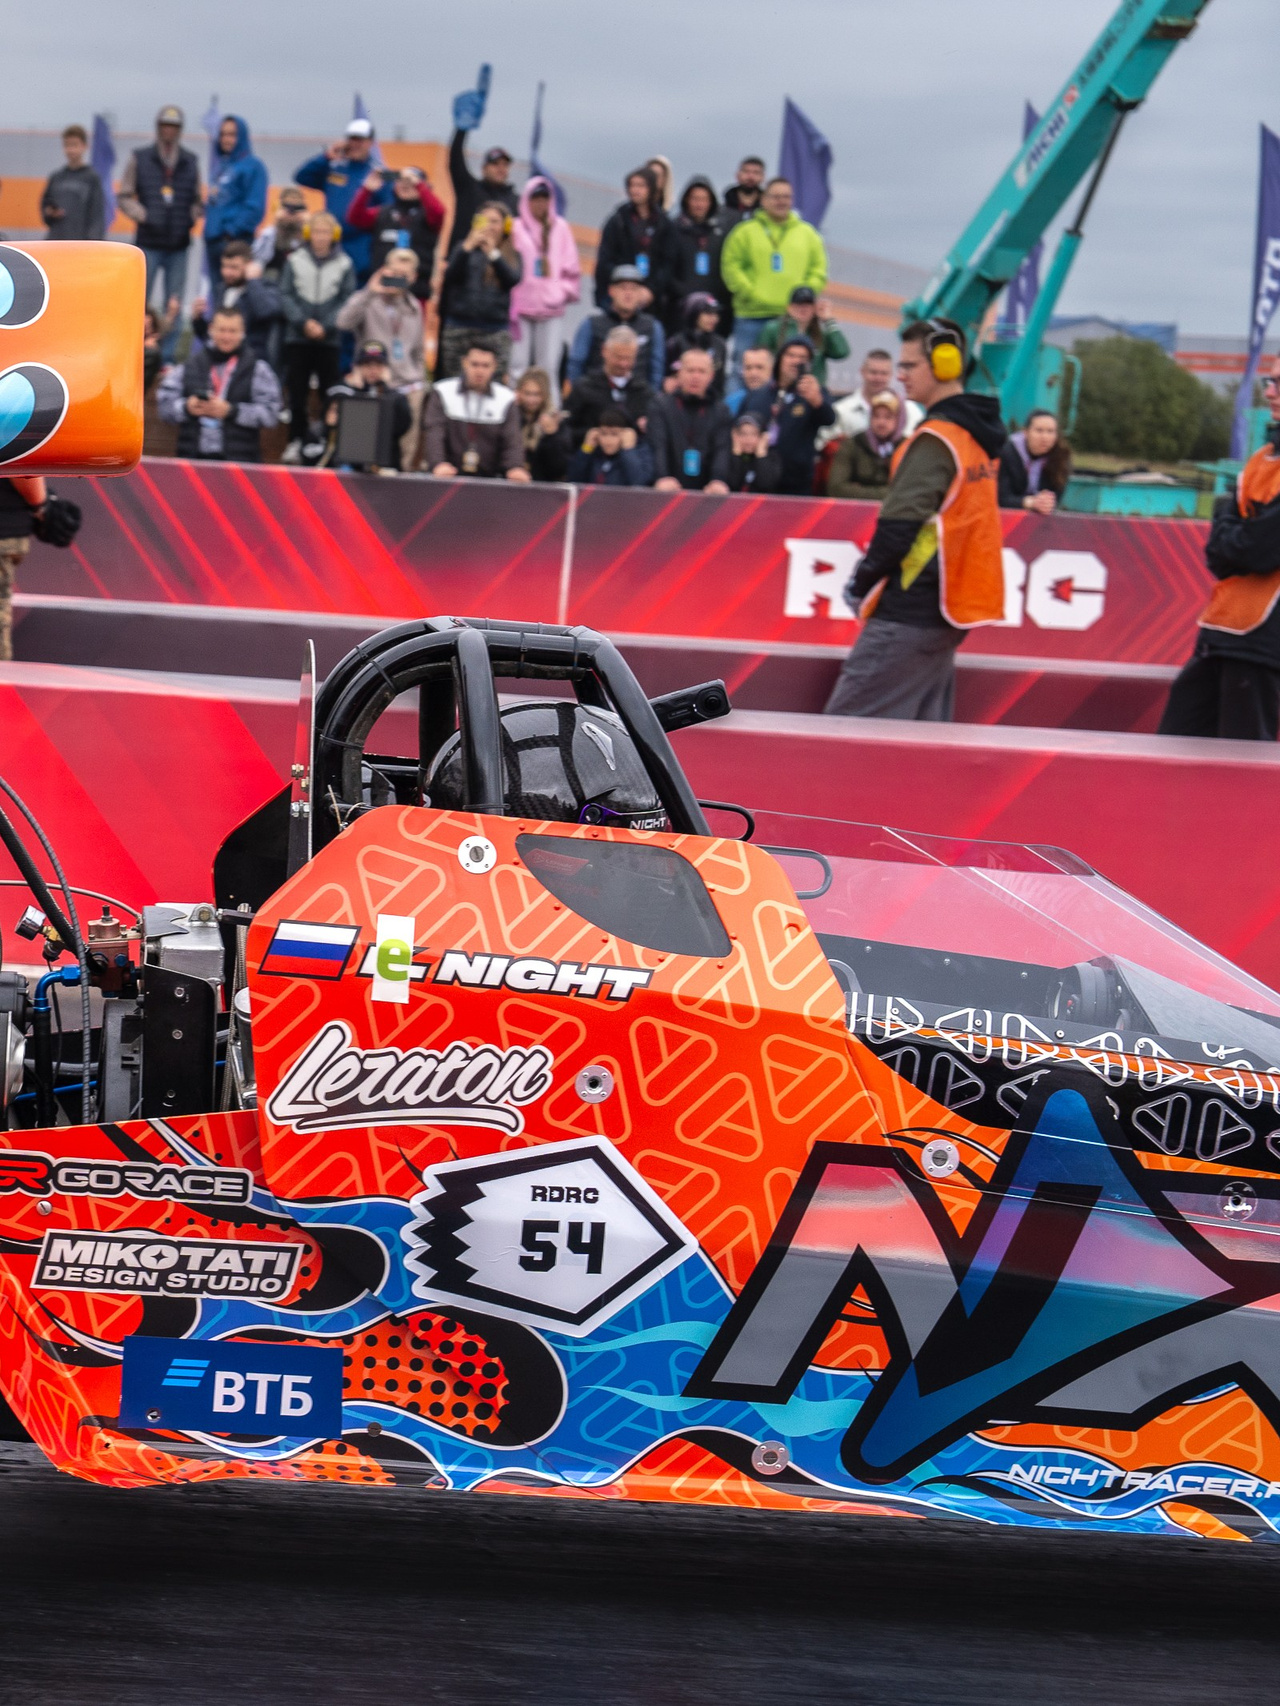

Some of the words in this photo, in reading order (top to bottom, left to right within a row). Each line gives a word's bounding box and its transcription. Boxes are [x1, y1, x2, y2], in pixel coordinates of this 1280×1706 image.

[630, 816, 666, 830] NIGHT
[434, 951, 654, 1000] NIGHT
[56, 1167, 244, 1197] GORACE
[531, 1185, 600, 1204] RDRC
[47, 1238, 292, 1276] MIKOTATI
[518, 1219, 607, 1275] 54
[41, 1266, 158, 1287] DESIGN
[166, 1272, 282, 1294] STUDIO
[212, 1370, 314, 1417] ВТБ
